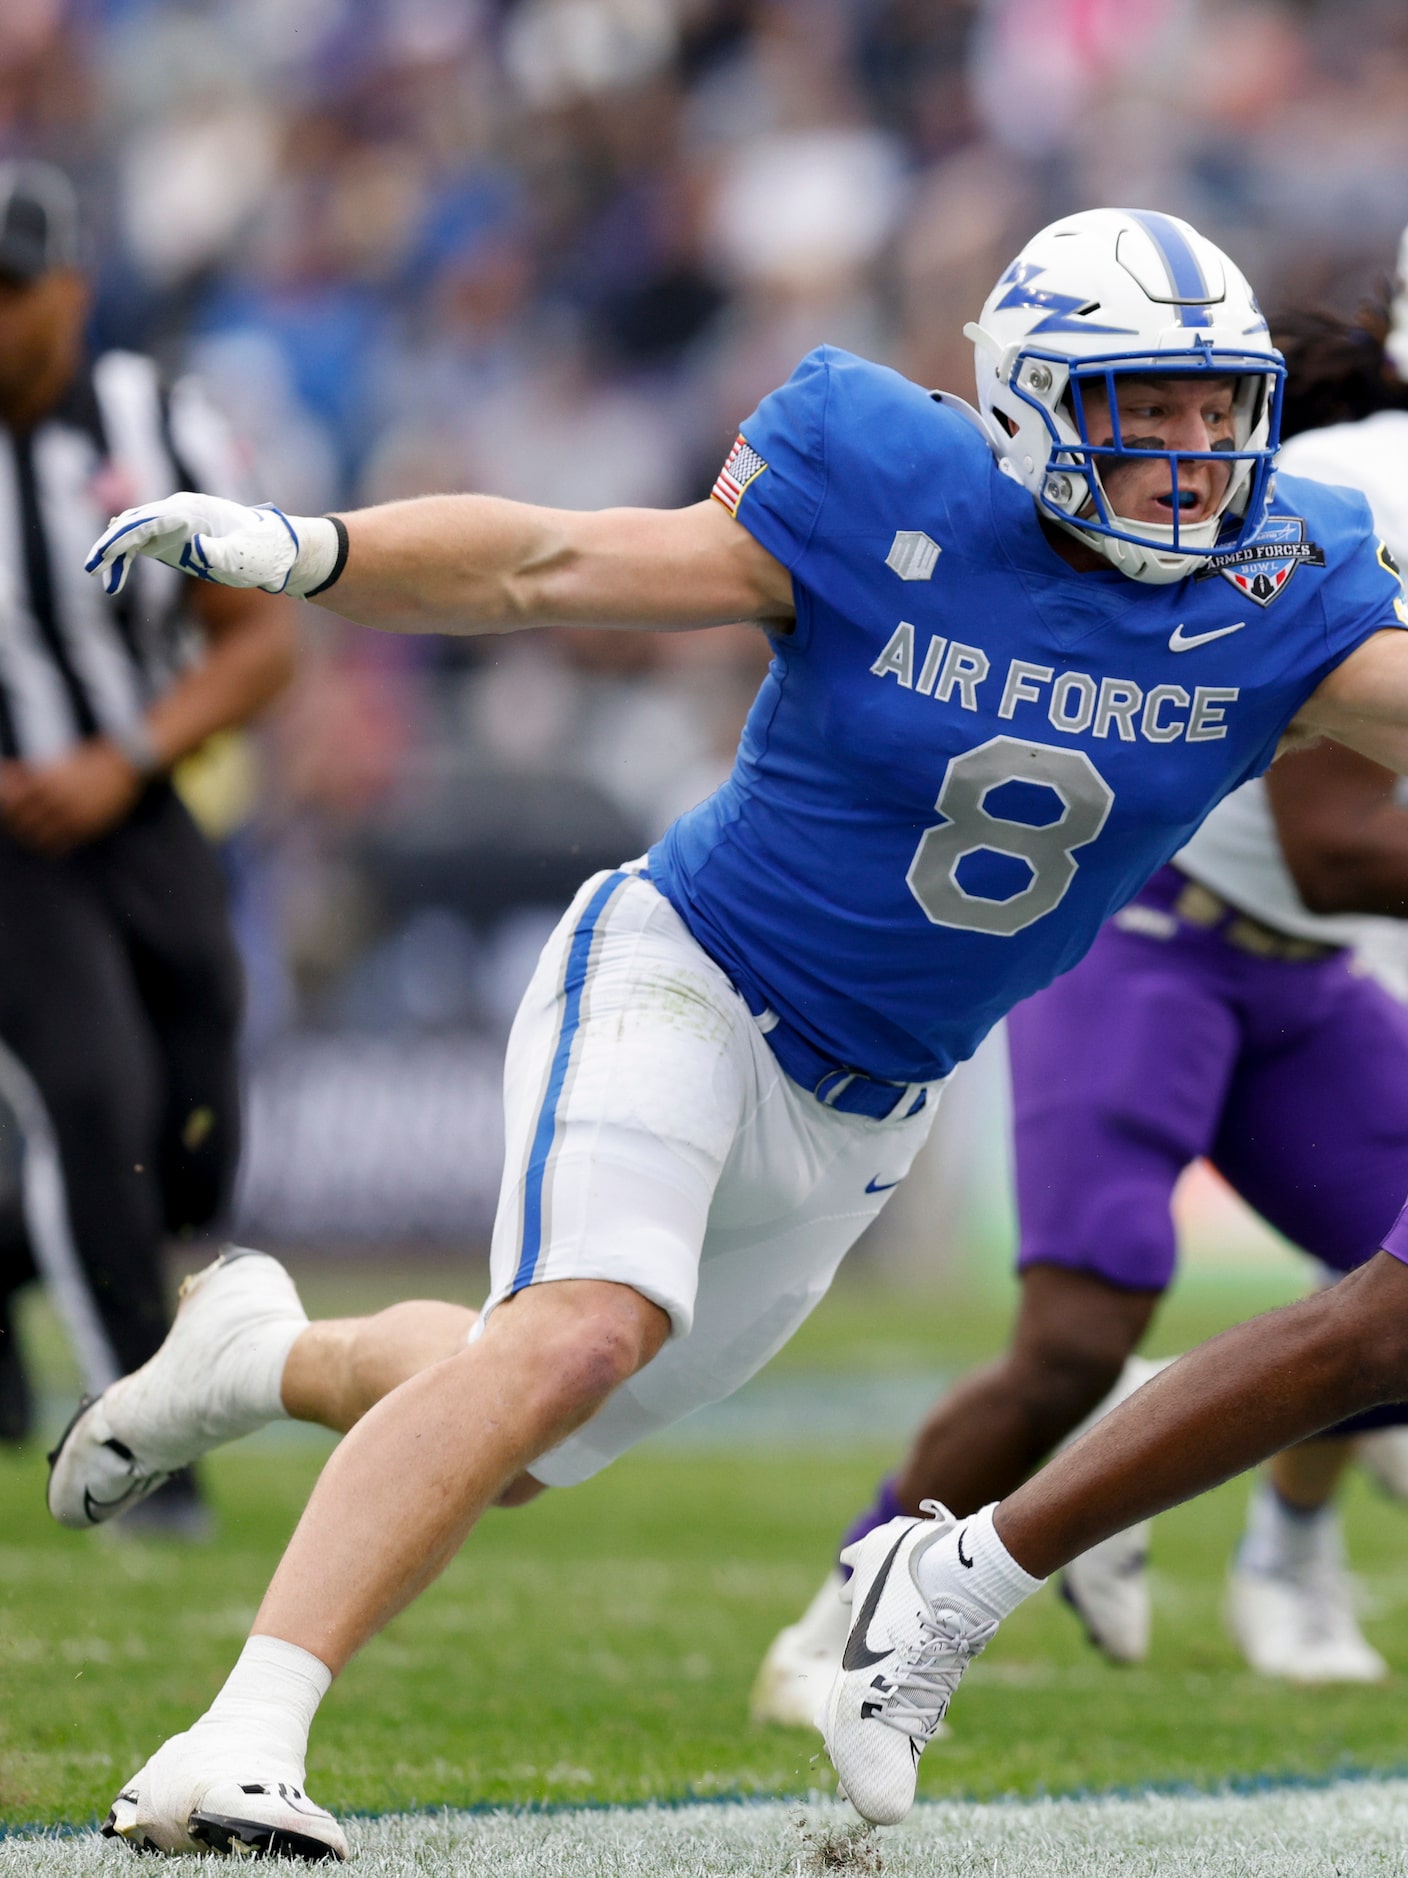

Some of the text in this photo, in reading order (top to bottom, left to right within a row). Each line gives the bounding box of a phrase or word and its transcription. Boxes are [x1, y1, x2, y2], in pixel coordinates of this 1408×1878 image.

[1207, 549, 1253, 570] ARMED
[1256, 544, 1311, 558] FORCES
[1241, 561, 1279, 574] BOWL
[870, 621, 1239, 742] AIR FORCE
[905, 734, 1115, 936] 8
